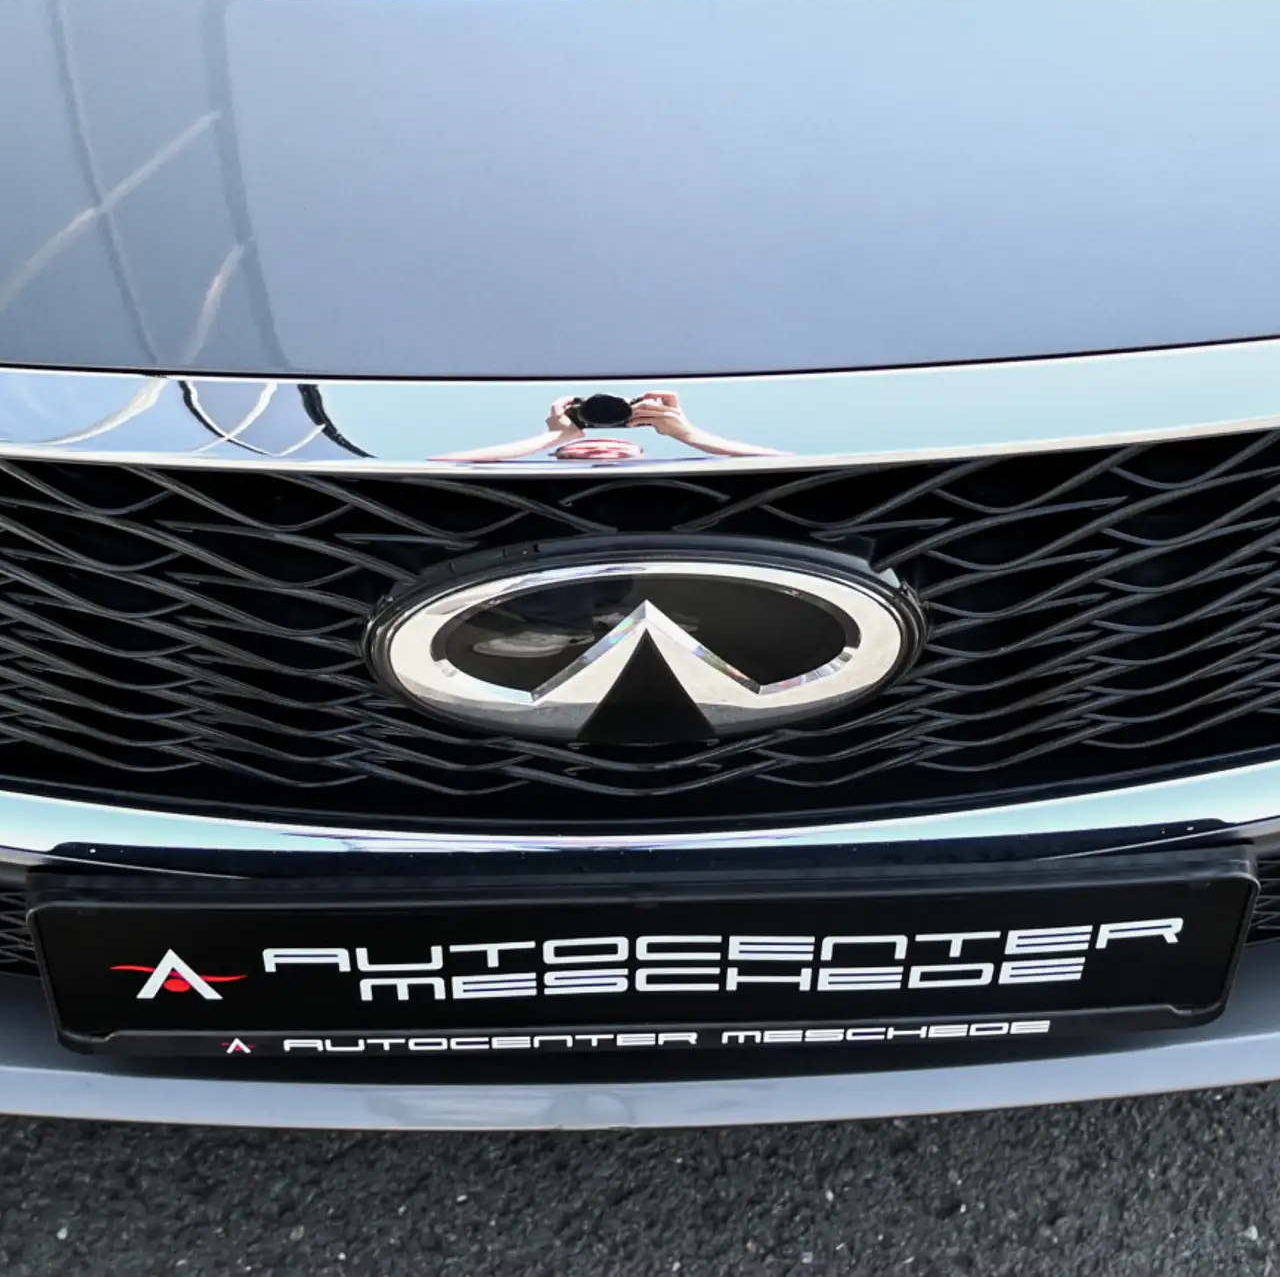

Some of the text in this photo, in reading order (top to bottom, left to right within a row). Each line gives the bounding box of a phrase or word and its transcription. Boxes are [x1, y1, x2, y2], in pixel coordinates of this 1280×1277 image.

[262, 917, 1184, 973] AUTOCENTER
[359, 956, 1086, 1001] MESCHEDE
[282, 1019, 1051, 1053] AUTOCENTER MESCHEDE
